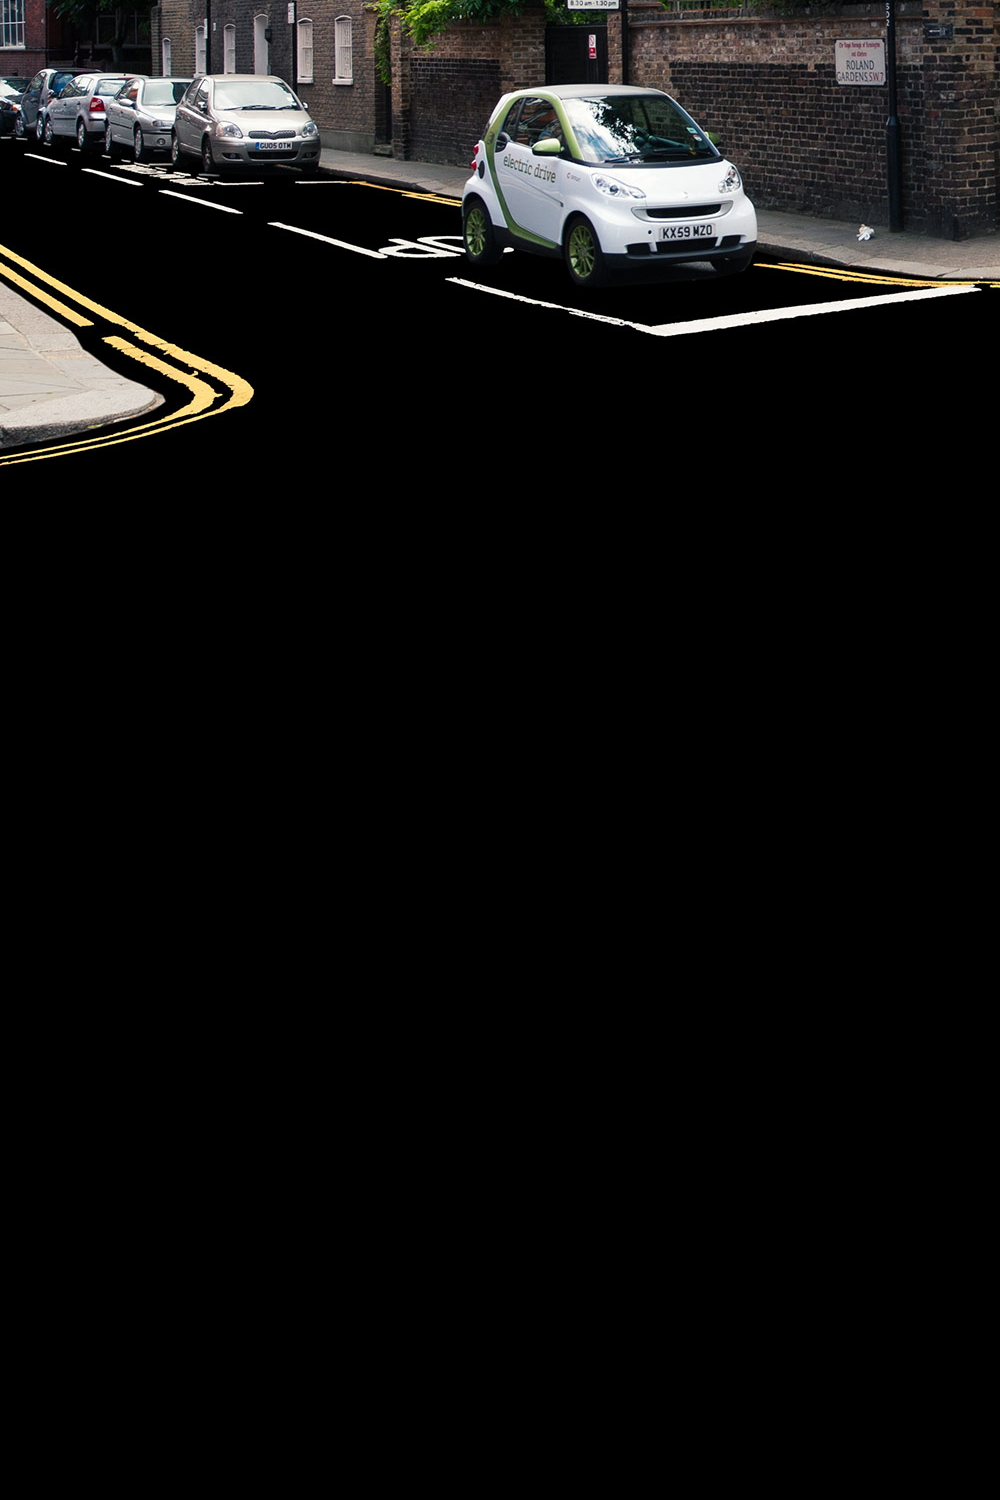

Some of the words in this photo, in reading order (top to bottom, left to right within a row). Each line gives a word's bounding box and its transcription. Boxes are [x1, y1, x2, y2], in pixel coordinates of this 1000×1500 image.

[846, 60, 875, 70] ROLAND
[503, 154, 533, 176] electric
[534, 164, 557, 183] drive
[662, 227, 691, 239] KX59
[693, 224, 713, 236] MZO
